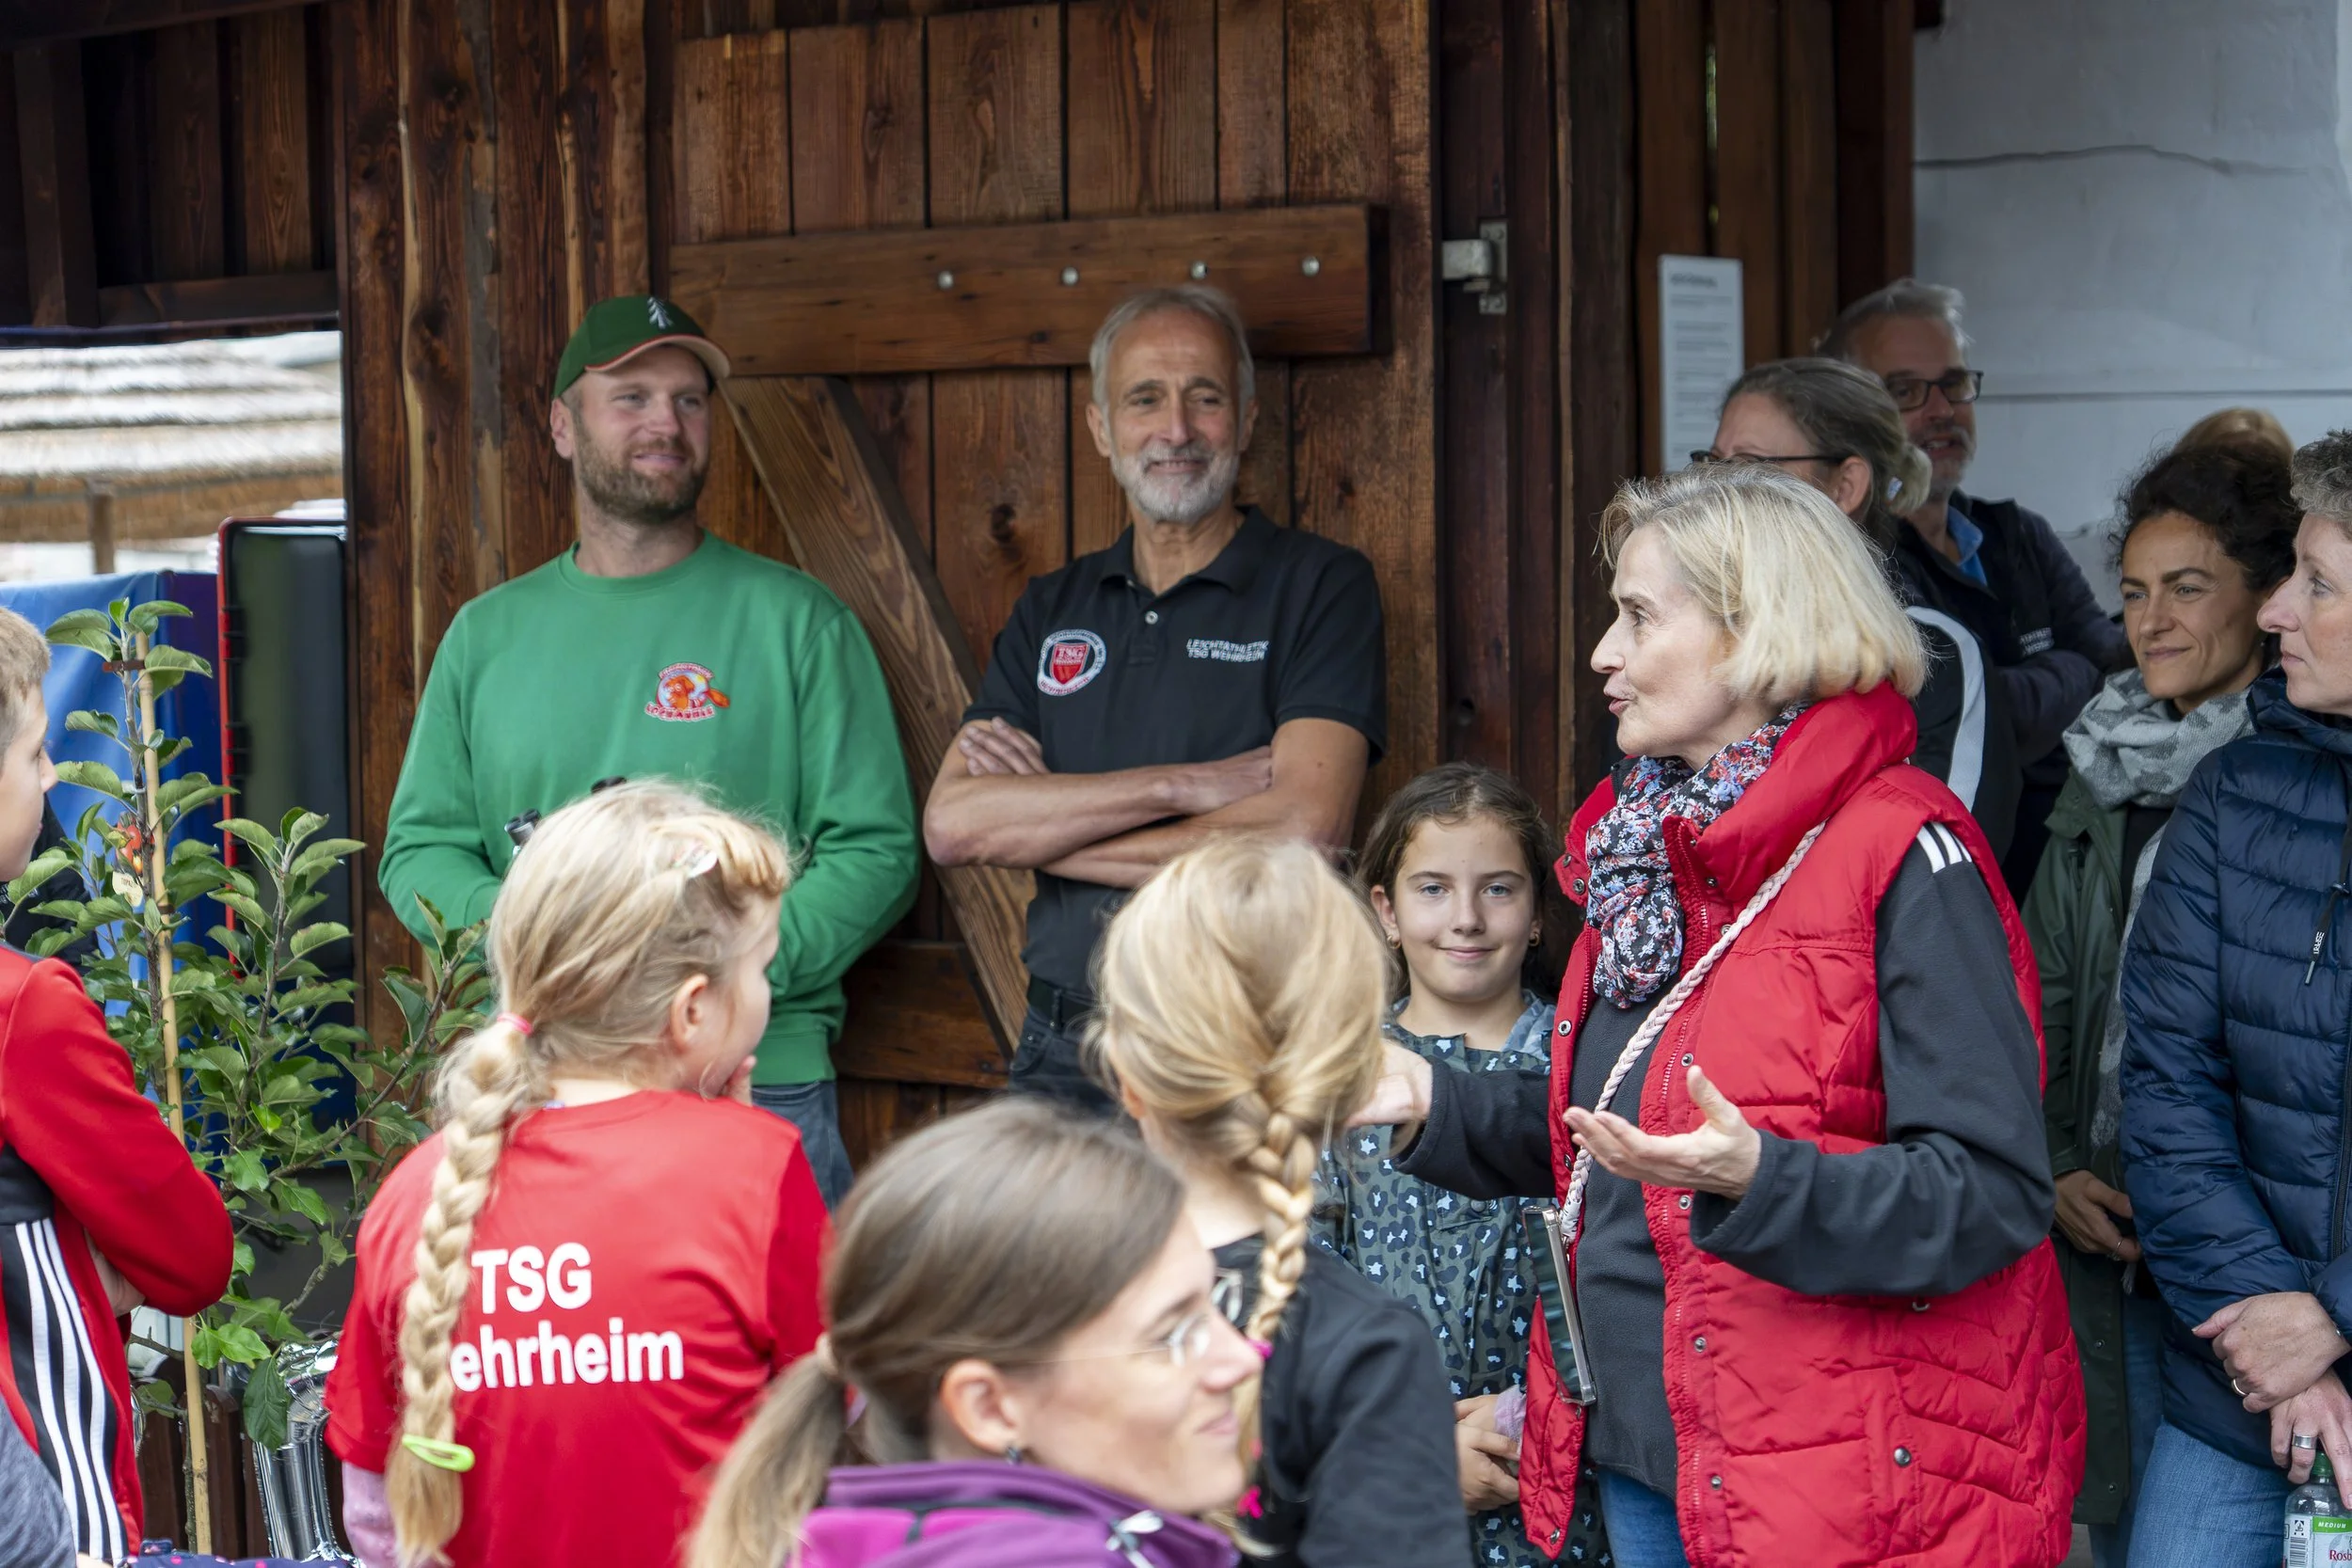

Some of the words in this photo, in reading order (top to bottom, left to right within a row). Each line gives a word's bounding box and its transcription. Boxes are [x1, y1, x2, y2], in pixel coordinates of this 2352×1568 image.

[1057, 647, 1084, 658] TSG
[471, 1242, 592, 1314] TSG
[449, 1317, 684, 1392] ehrheim
